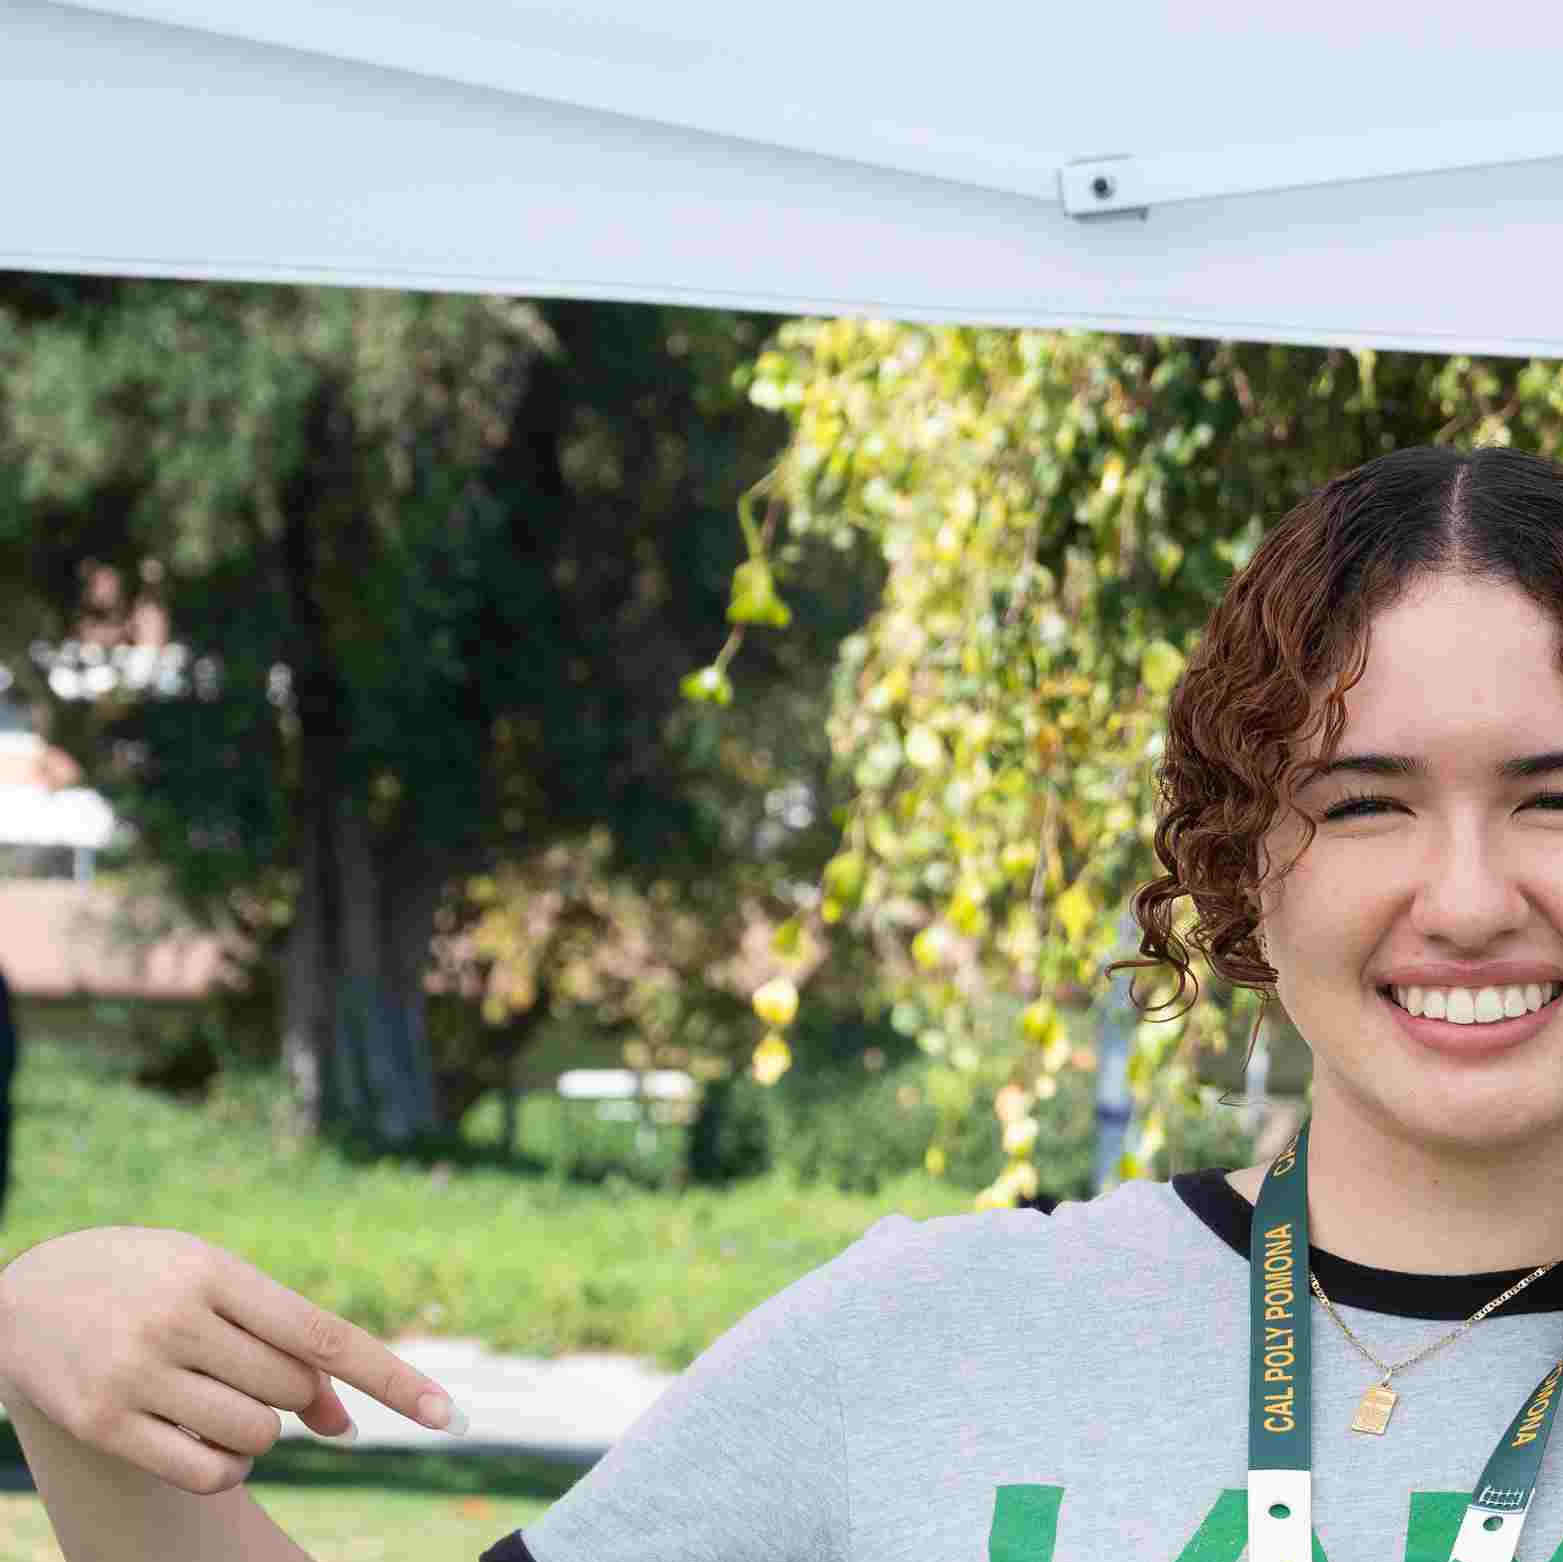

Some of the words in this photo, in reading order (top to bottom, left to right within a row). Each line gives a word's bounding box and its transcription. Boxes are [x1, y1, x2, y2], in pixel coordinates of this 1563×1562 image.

[1263, 1223, 1297, 1321] POMONA
[1264, 1327, 1296, 1383] POLY
[1264, 1387, 1295, 1433] CAL
